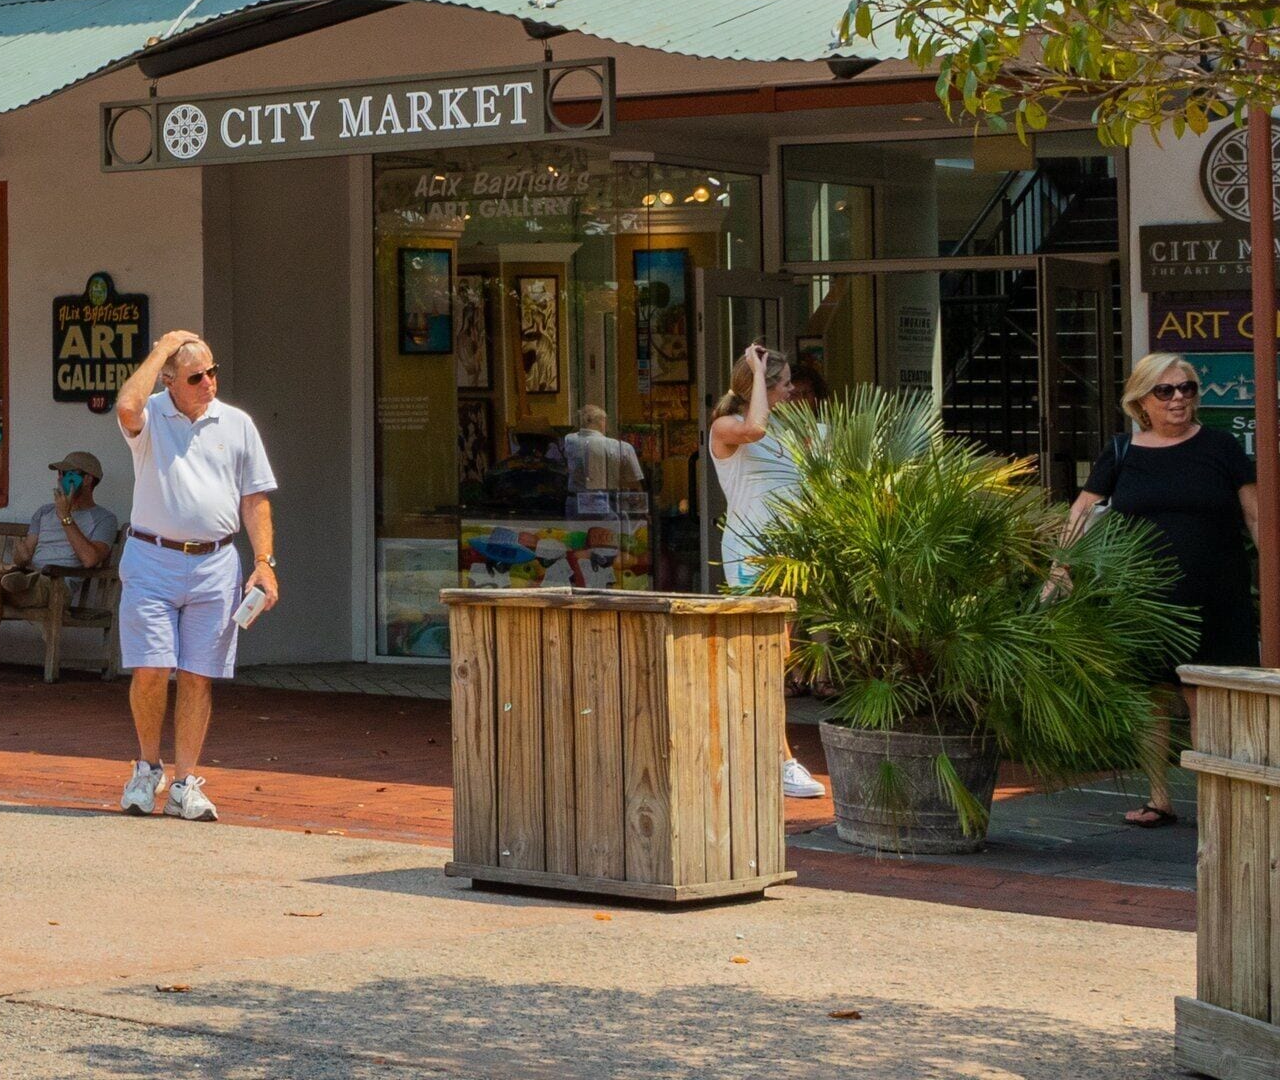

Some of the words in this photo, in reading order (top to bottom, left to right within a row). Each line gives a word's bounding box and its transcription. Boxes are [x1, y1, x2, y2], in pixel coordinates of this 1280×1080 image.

[220, 100, 320, 149] CITY
[338, 82, 533, 139] MARKET
[428, 201, 469, 220] ART
[479, 196, 574, 218] GALLERY
[1148, 240, 1222, 262] CITY
[1158, 311, 1230, 339] ART
[58, 324, 139, 359] ART
